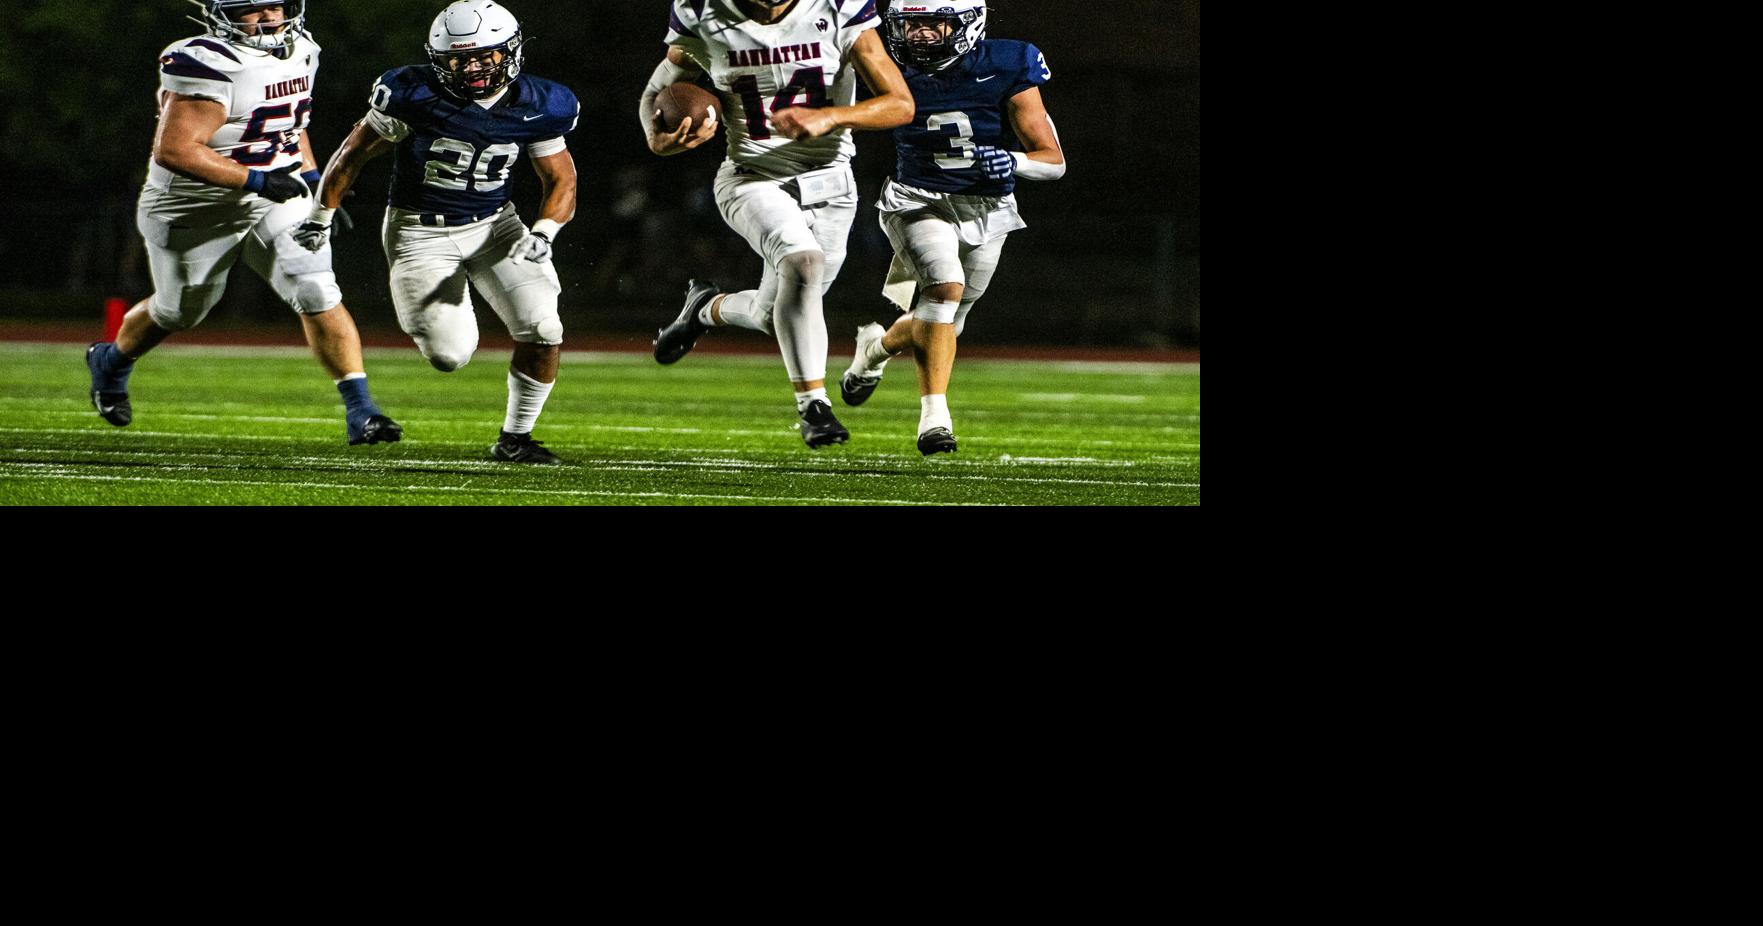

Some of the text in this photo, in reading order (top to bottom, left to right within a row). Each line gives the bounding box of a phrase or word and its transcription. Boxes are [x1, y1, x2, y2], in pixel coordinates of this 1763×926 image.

[727, 42, 821, 67] MANHATTAN
[1036, 52, 1052, 81] 3
[732, 66, 834, 141] 14
[423, 137, 519, 192] 20
[927, 111, 976, 169] 3
